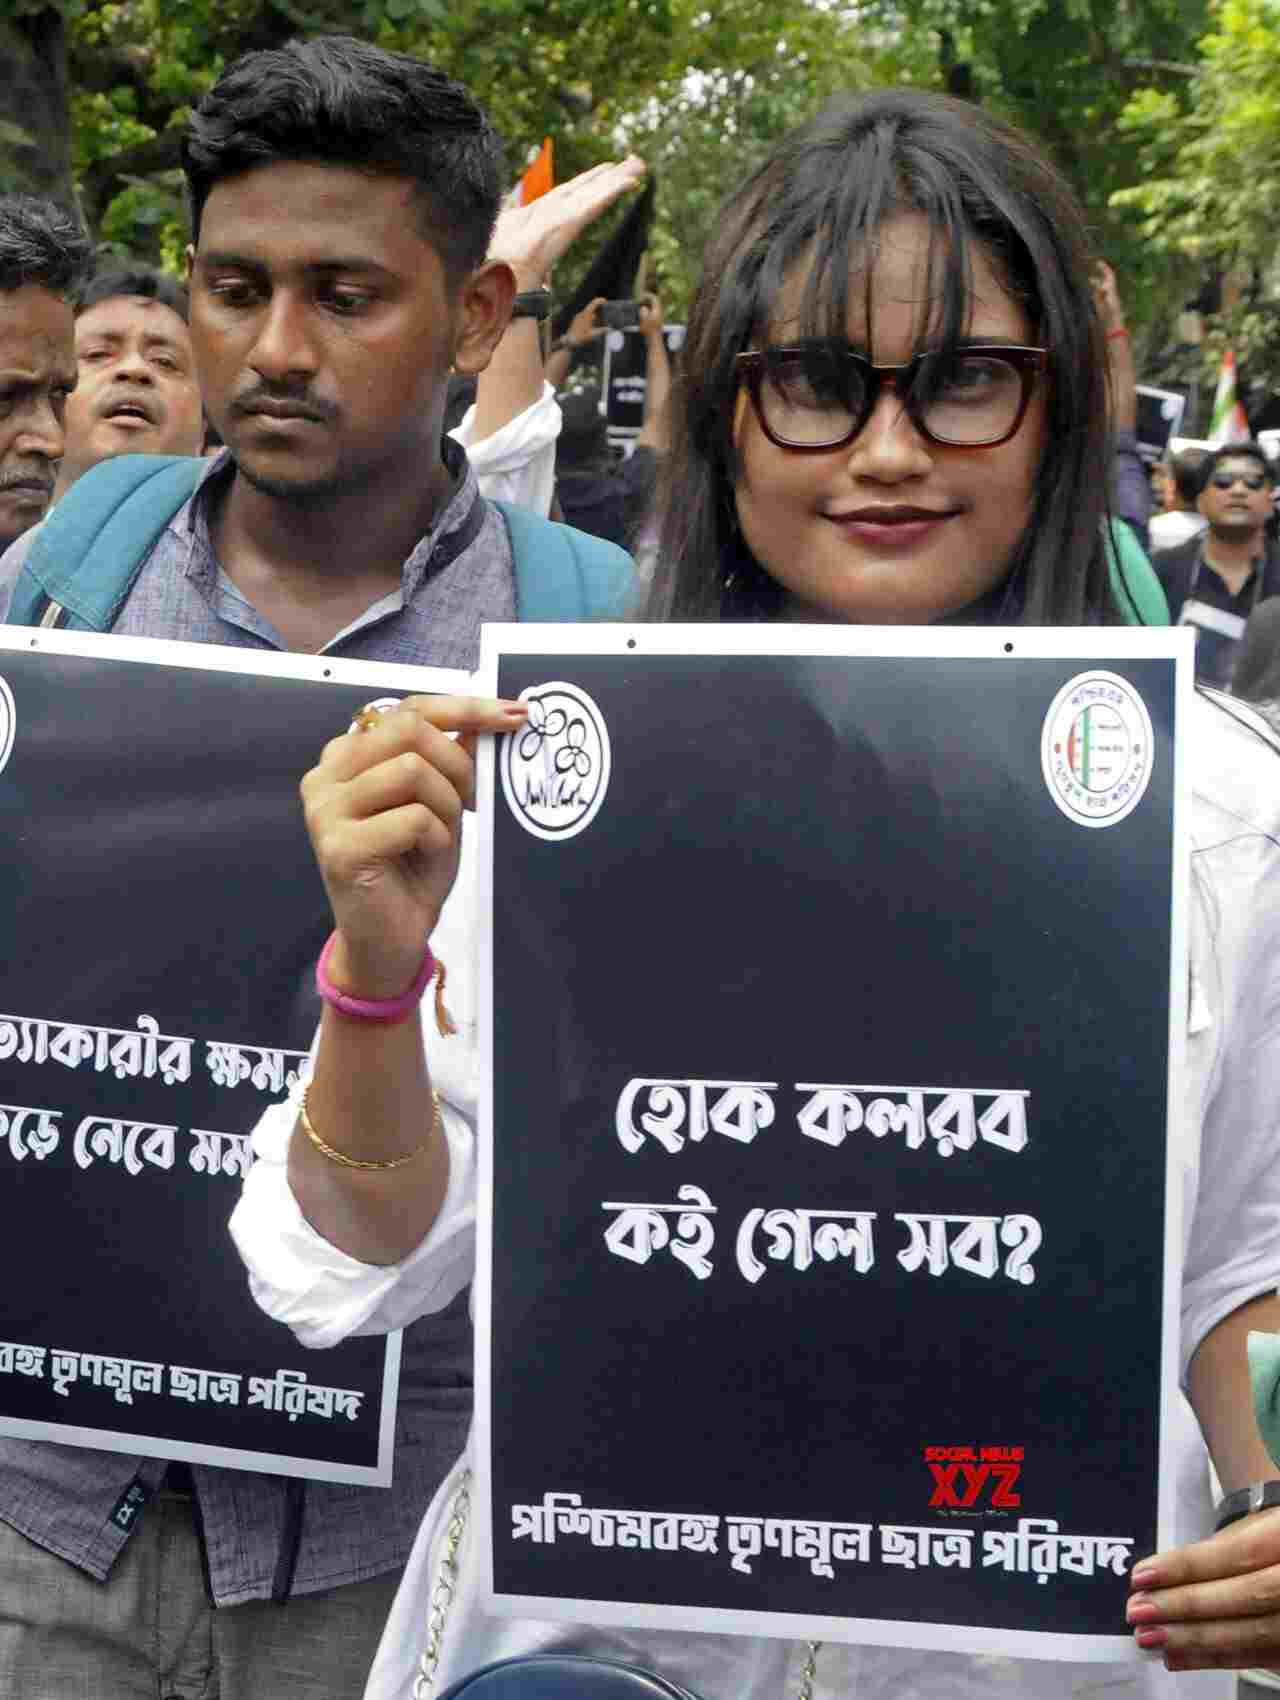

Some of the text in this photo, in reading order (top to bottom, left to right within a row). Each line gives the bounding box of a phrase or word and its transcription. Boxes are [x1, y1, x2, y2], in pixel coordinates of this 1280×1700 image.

[73, 1115, 179, 1176] নেবে
[189, 1128, 254, 1178] মম
[615, 1077, 1031, 1158] হোক কলরব
[601, 1184, 1043, 1285] কই গেল সব?
[50, 1348, 165, 1405] তৃণমূল
[168, 1365, 243, 1405] ছাত্র
[247, 1368, 365, 1422] পরিষদ
[511, 1491, 1134, 1585] পশ্চিমবঙ্গ তৃণমূল ছাত্র পরিষদ
